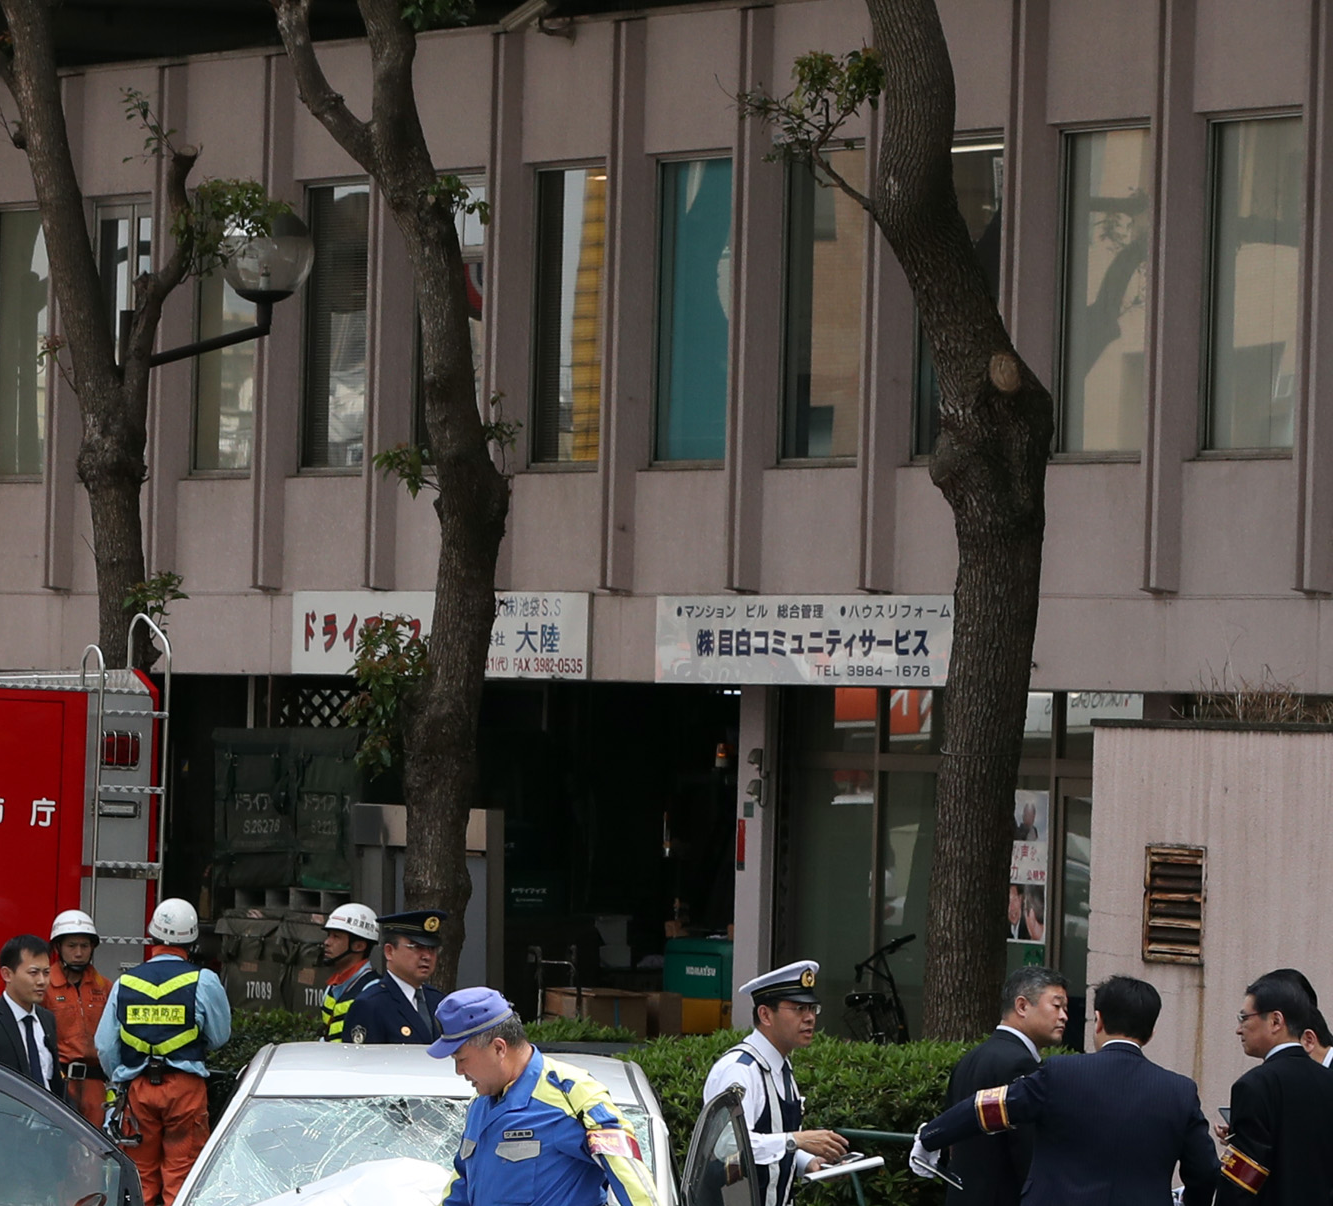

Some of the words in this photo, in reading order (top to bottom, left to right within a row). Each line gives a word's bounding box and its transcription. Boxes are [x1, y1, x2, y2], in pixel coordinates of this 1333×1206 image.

[685, 604, 736, 619] マンション
[746, 604, 768, 618] ビル
[777, 604, 824, 619] 総合管理
[849, 604, 951, 619] ハウスリフォーム
[515, 621, 561, 654] 大陸
[513, 657, 531, 673] FAX
[533, 657, 583, 674] 3982-0535
[815, 665, 840, 677] TEL
[847, 664, 931, 677] 3984-1678
[685, 964, 717, 977] KOMATSU
[246, 981, 272, 999] 17089
